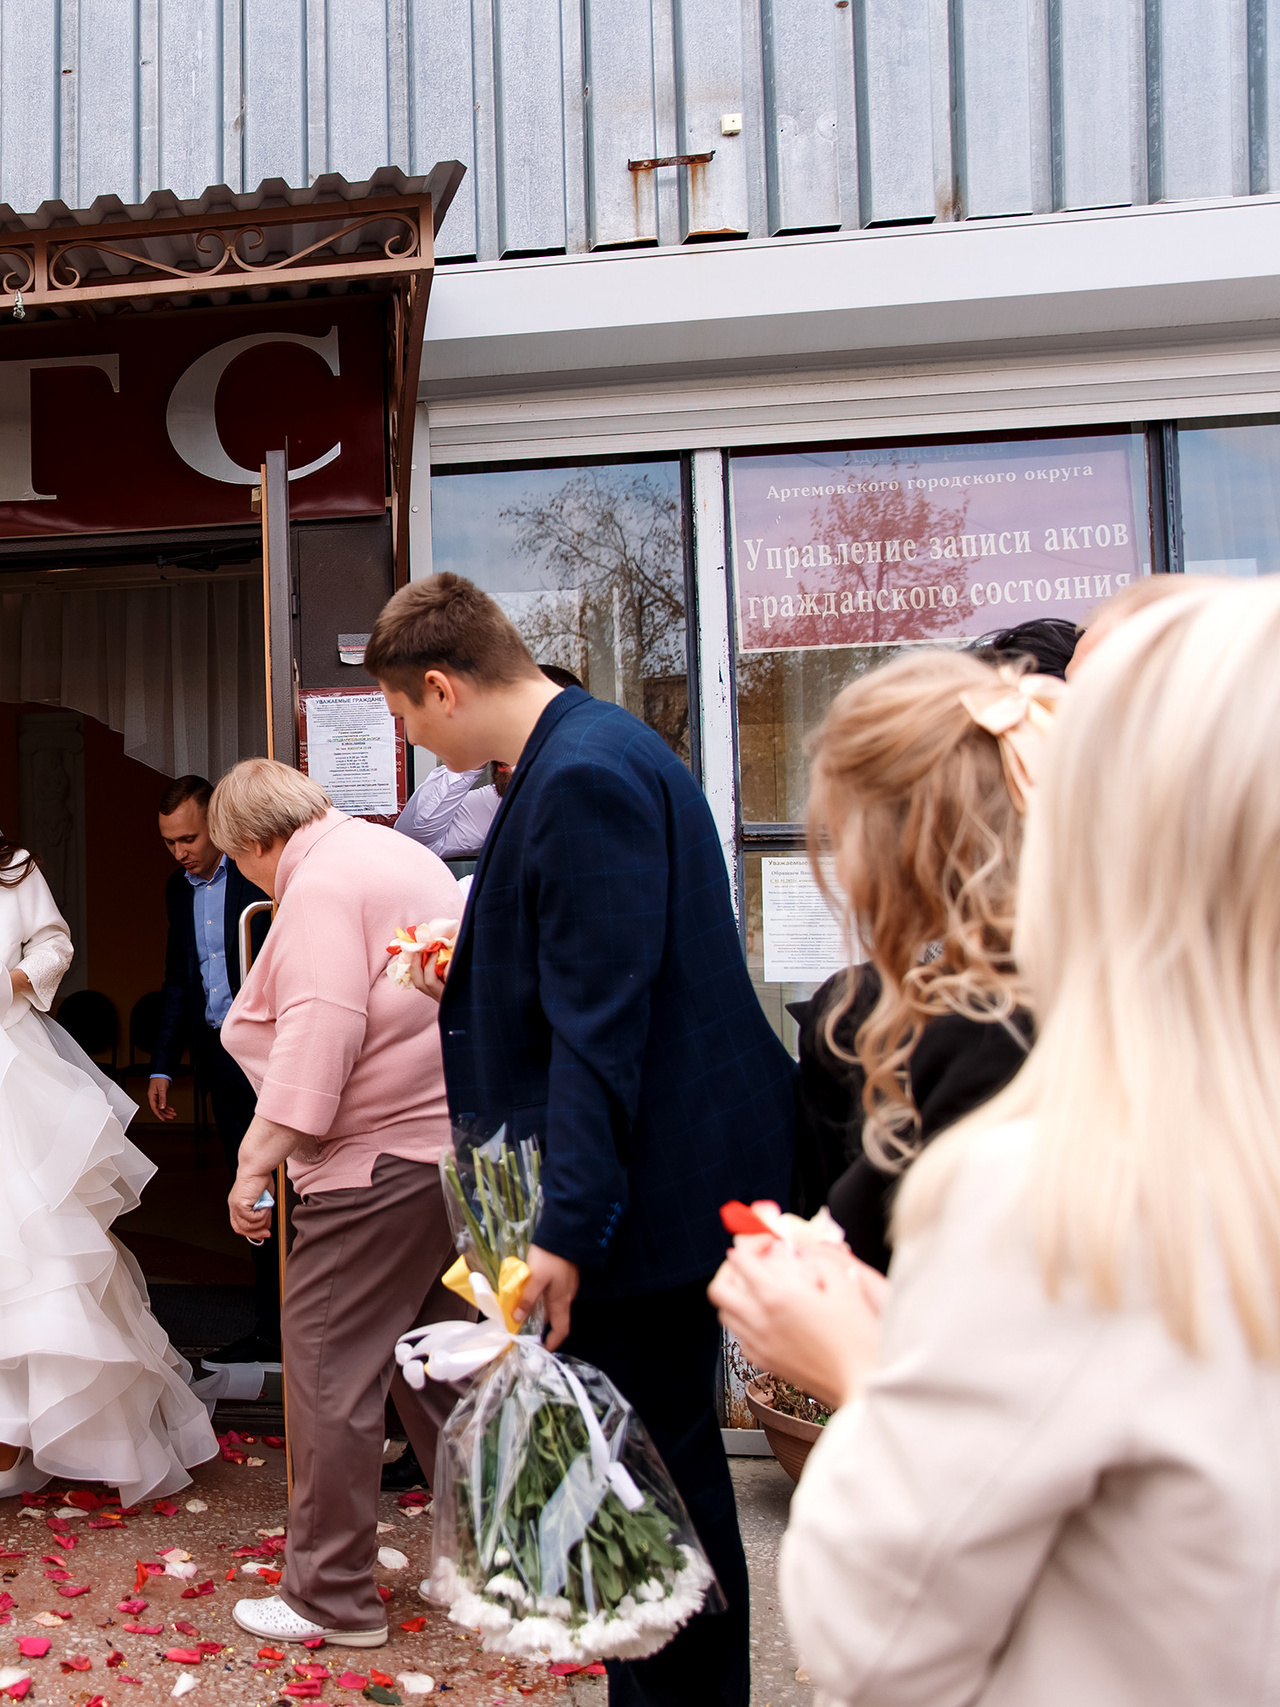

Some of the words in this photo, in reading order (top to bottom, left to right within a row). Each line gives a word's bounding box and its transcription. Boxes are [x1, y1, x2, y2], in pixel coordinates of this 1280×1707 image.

[766, 478, 900, 499] Артемовского
[907, 472, 1016, 492] городского
[1024, 464, 1093, 483] округа
[743, 538, 917, 578] Управление
[928, 530, 1032, 560] записи
[1044, 523, 1129, 551] актов
[748, 584, 957, 628] гражданского
